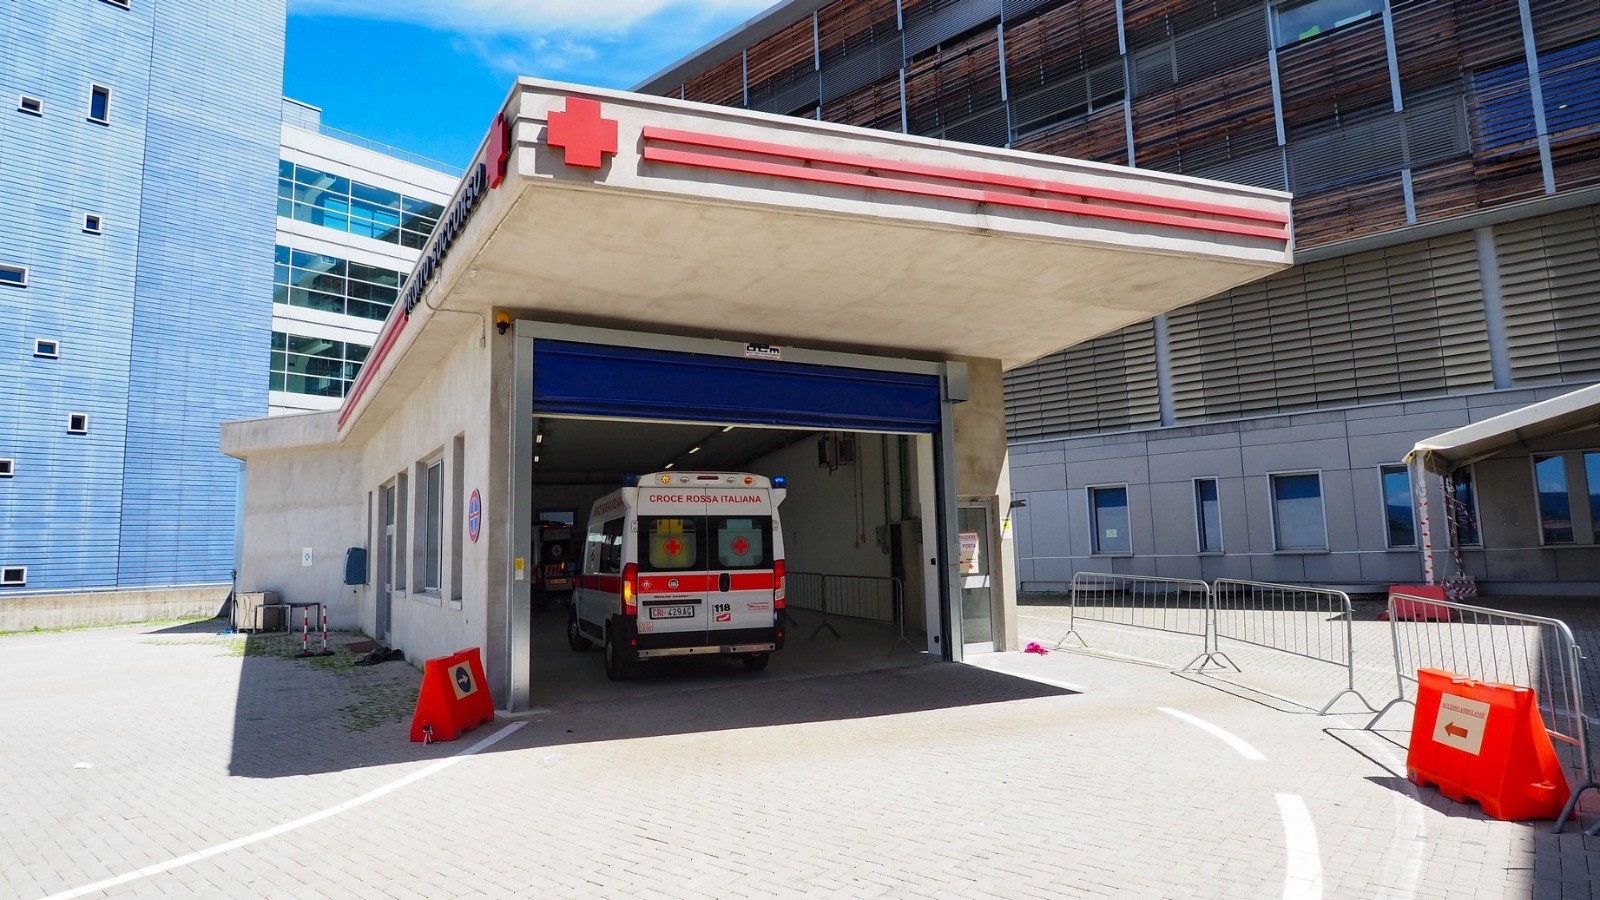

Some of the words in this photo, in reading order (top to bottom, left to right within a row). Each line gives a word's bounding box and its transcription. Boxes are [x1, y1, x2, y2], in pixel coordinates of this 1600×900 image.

[430, 163, 487, 270] SOCCORSO
[649, 494, 684, 504] CROCE
[686, 494, 719, 503] ROSSA
[721, 494, 762, 503] ITALIANA
[714, 603, 731, 612] 118
[652, 608, 664, 617] CRI
